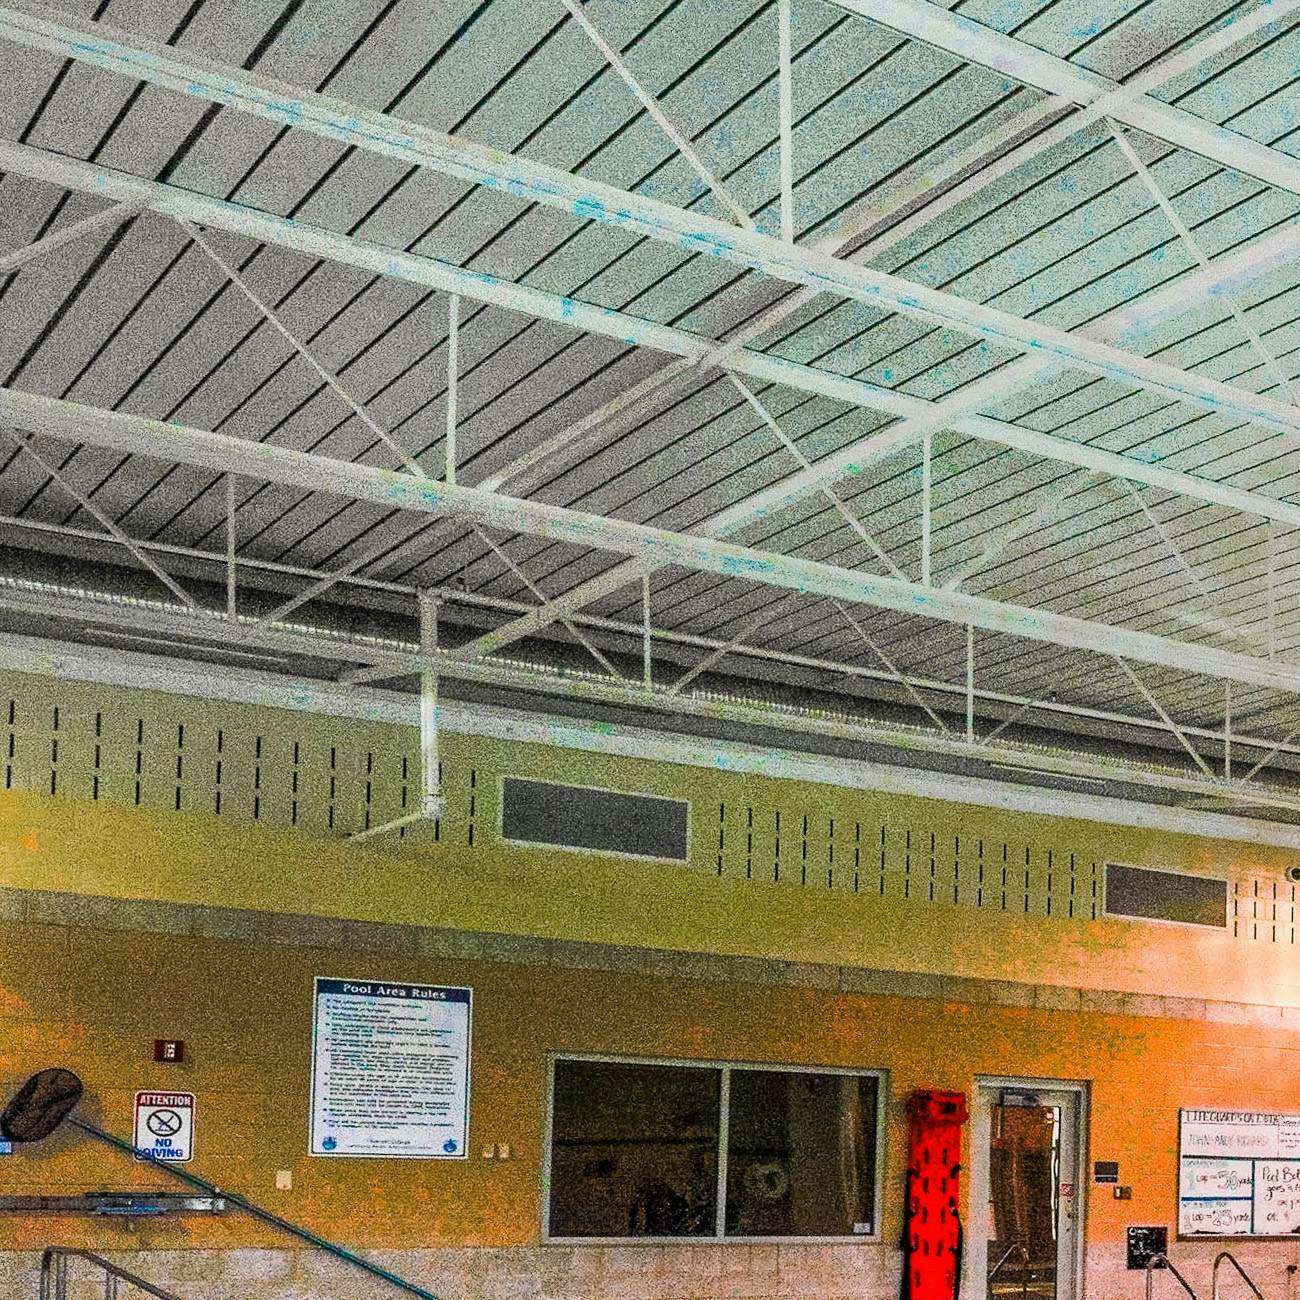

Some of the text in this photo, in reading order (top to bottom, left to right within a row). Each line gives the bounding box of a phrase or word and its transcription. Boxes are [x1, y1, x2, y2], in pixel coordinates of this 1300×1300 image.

[343, 983, 447, 999] Pool Area Rules
[140, 1095, 191, 1107] ATTENTION
[155, 1138, 172, 1147] NO
[143, 1149, 183, 1159] DIVING
